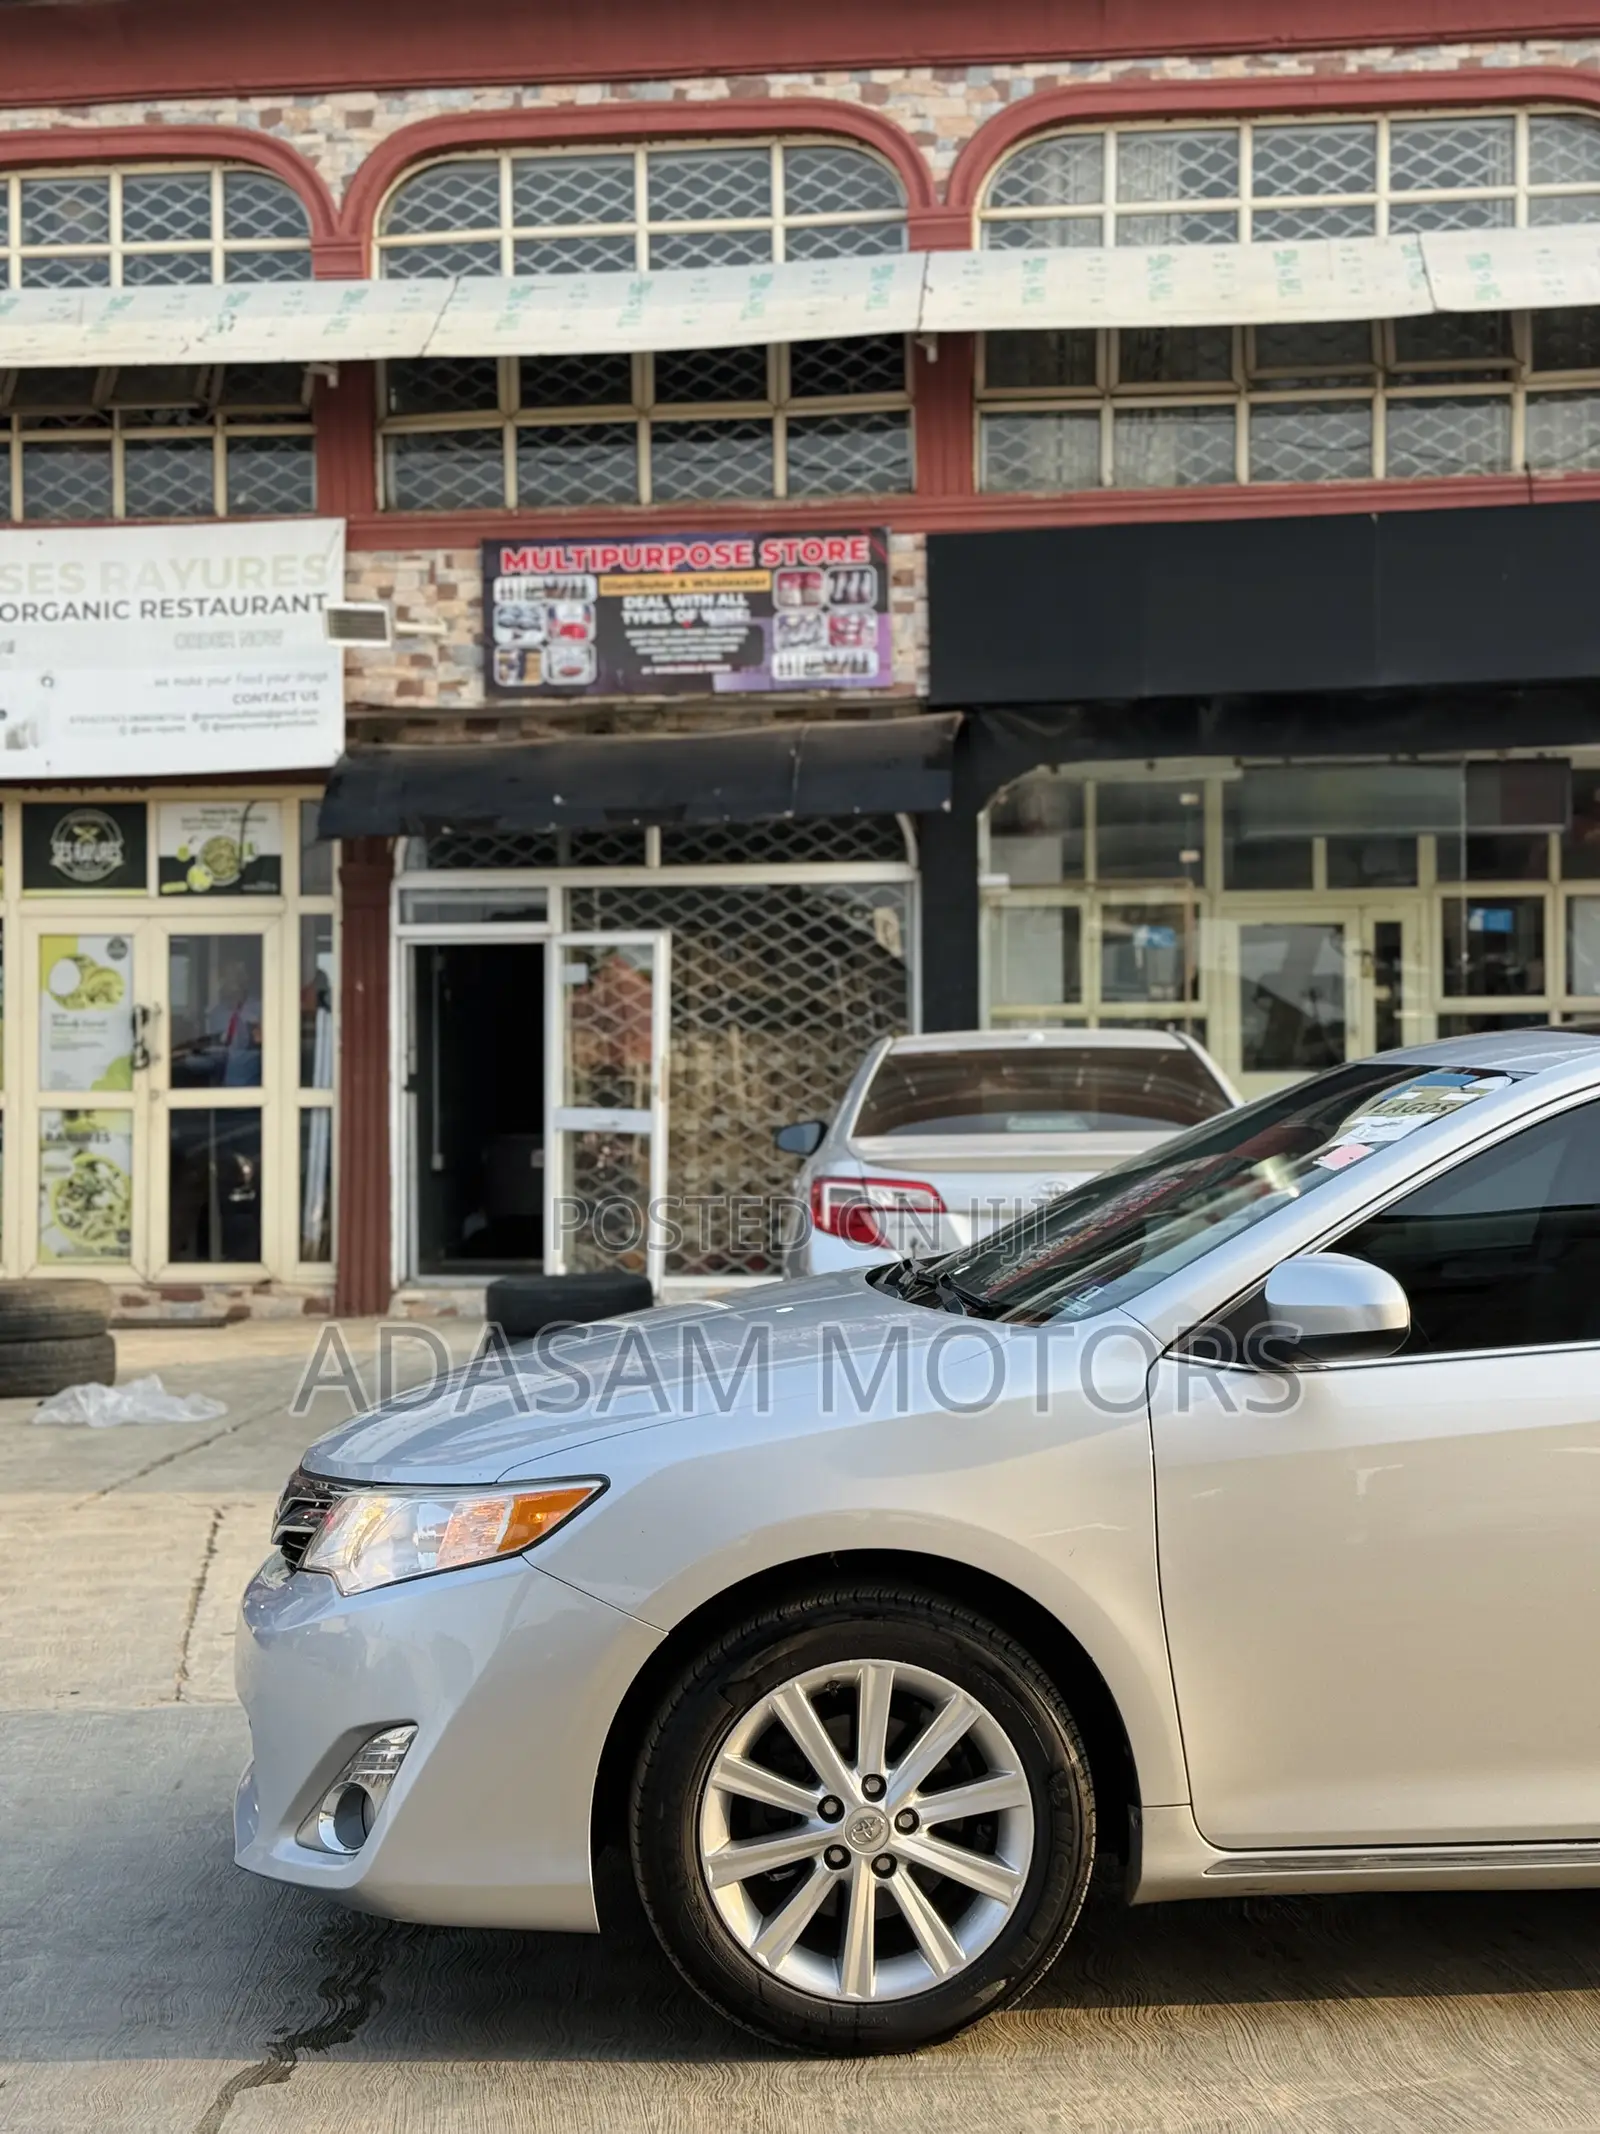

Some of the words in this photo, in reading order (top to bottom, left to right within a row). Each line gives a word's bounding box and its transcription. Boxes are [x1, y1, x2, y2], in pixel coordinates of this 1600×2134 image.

[500, 541, 755, 575] MULTIPURPOSE
[760, 536, 871, 567] STORE
[0, 560, 86, 597] SES
[99, 553, 328, 594] RAYURES
[0, 600, 130, 623] ORGANIC
[140, 594, 328, 619] RESTAURANT
[622, 594, 668, 610] DEAL
[669, 593, 715, 609] WITH
[716, 592, 750, 607] ALL
[232, 692, 297, 705] CONTACT
[301, 690, 320, 701] US
[1374, 1102, 1456, 1114] LAGOS
